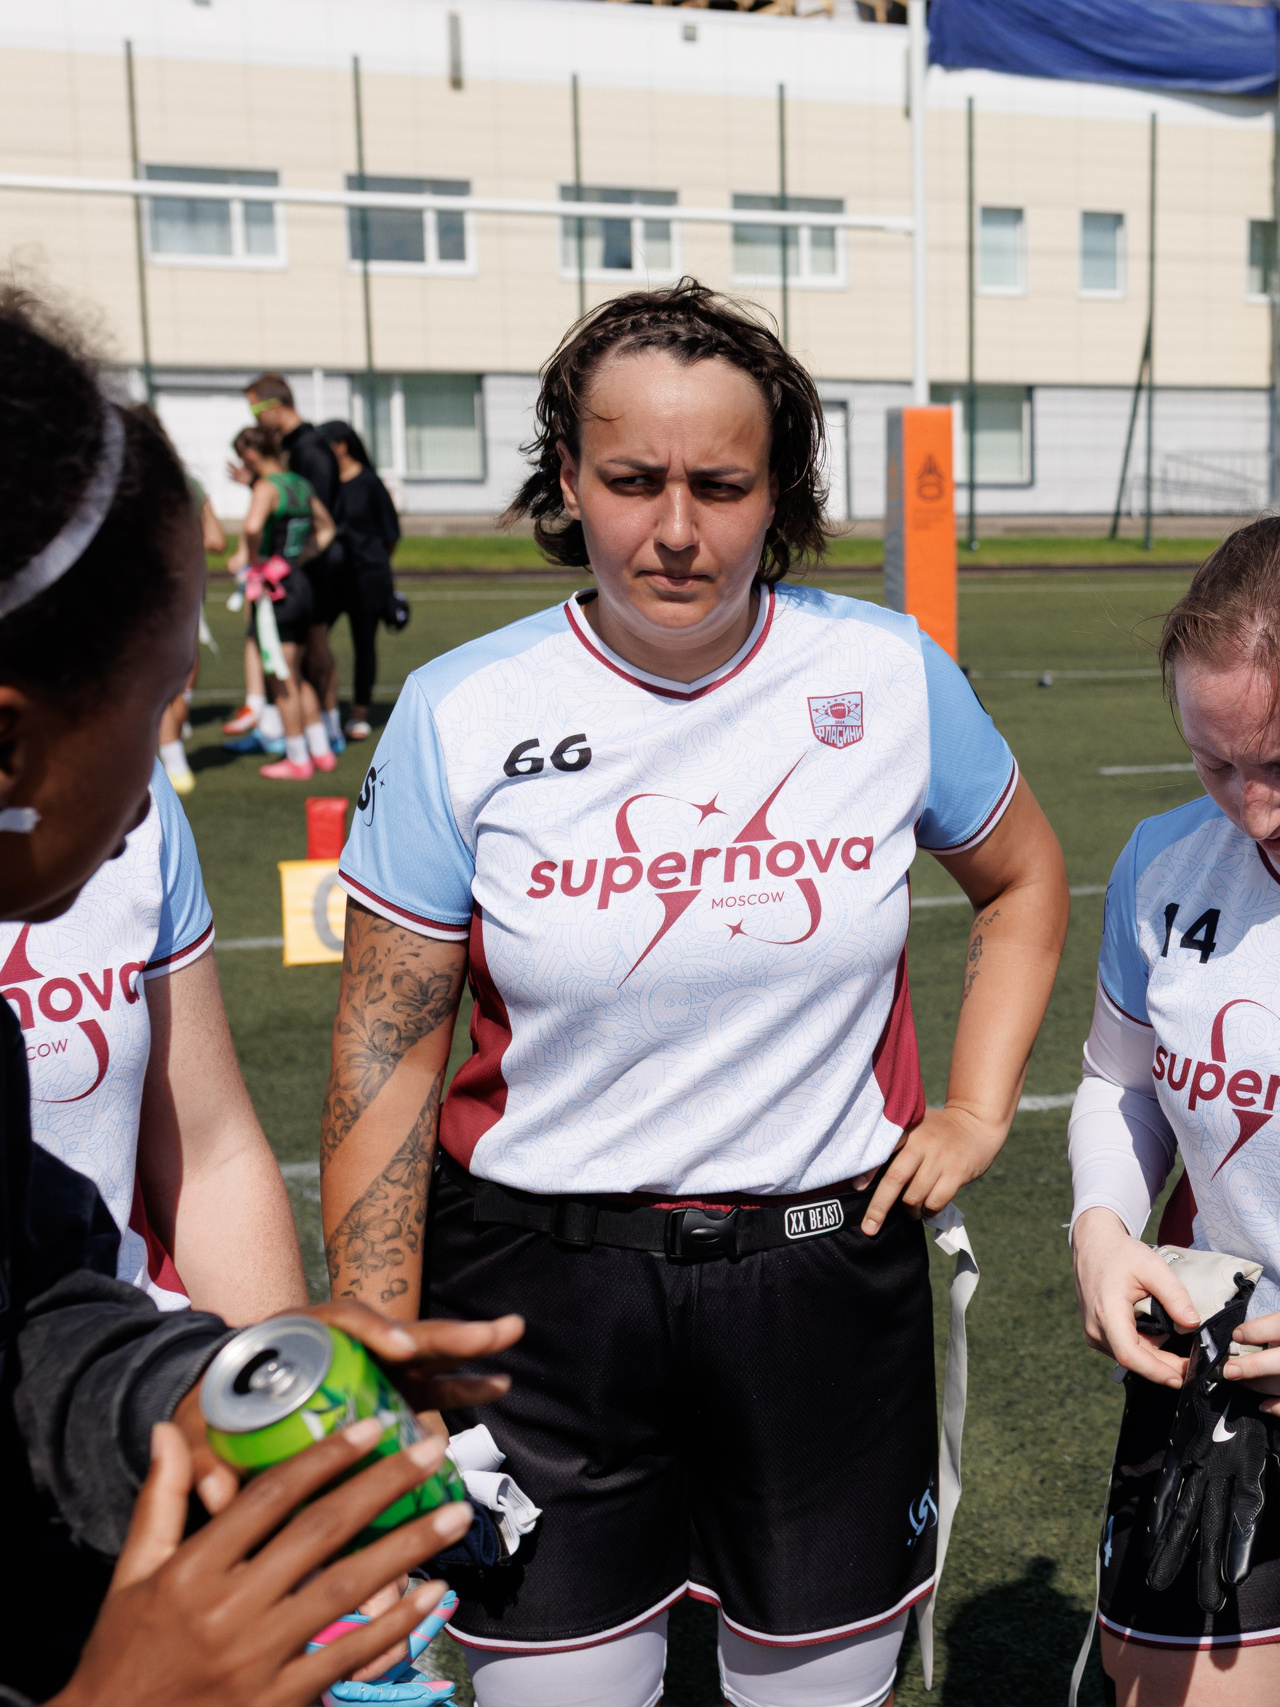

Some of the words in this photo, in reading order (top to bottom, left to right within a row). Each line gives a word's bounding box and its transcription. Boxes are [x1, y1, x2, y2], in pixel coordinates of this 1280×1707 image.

[503, 732, 592, 778] 66
[527, 835, 874, 910] supernova
[711, 890, 785, 910] MOSCOW
[1163, 902, 1221, 964] 14
[26, 1039, 68, 1060] COW
[789, 1212, 806, 1234] XX
[809, 1203, 840, 1230] BEAST
